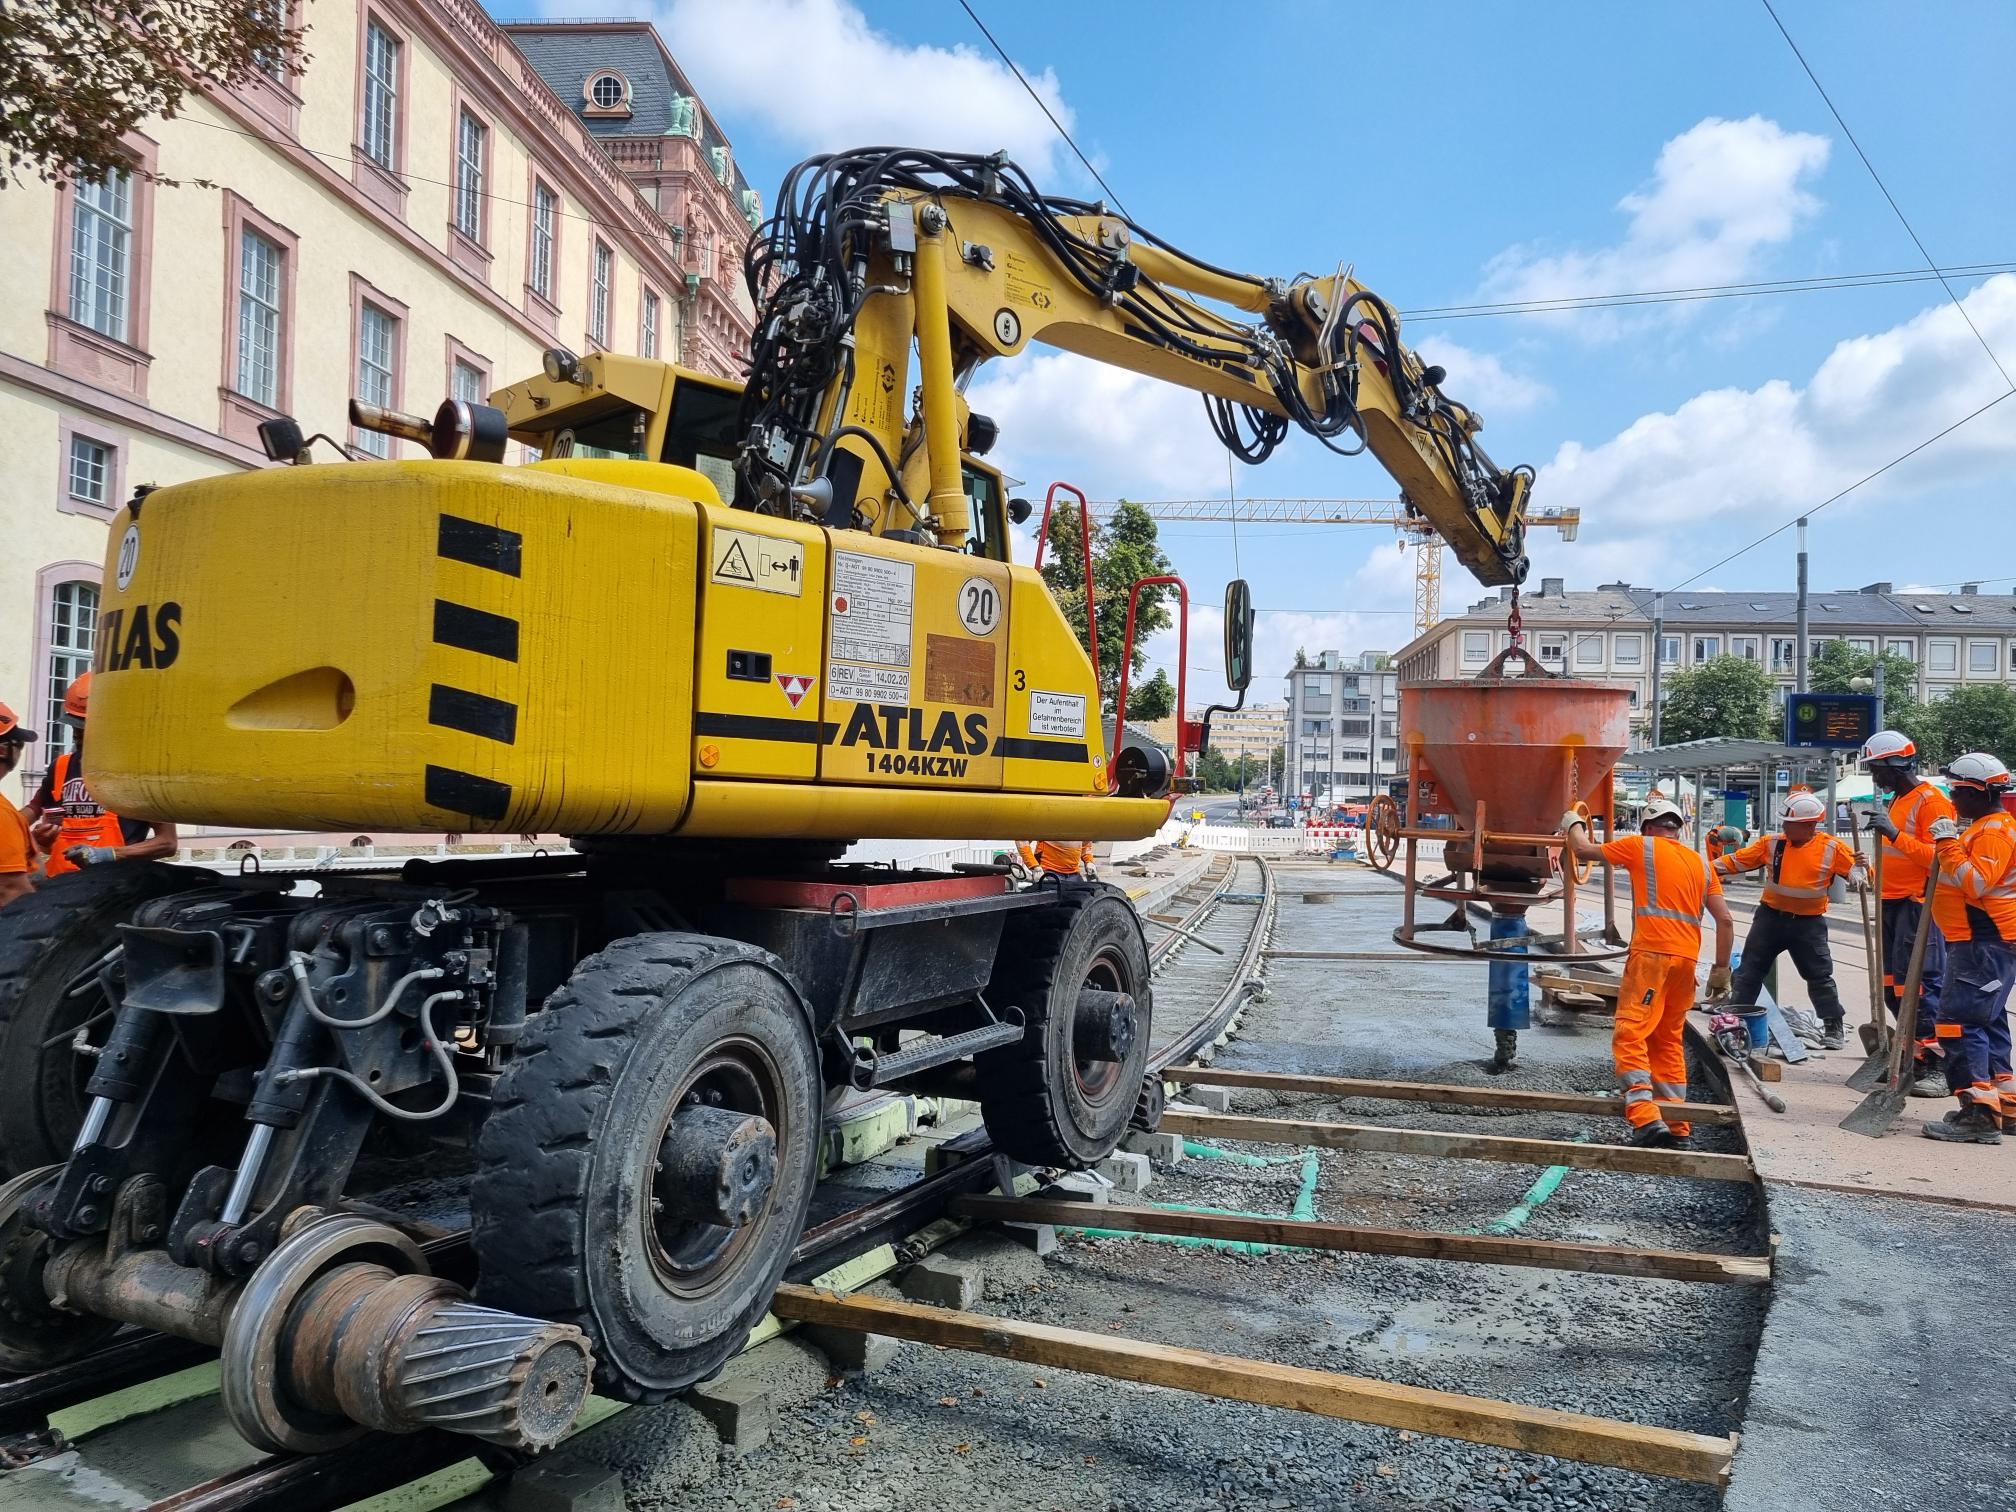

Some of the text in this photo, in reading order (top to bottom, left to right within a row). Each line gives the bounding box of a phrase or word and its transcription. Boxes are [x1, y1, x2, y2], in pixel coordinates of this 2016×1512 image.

[119, 536, 136, 578] 20
[966, 586, 993, 626] 20
[96, 601, 182, 673] TLAS
[831, 667, 837, 678] 6
[838, 668, 854, 680] REV
[876, 672, 908, 686] 14.02.20
[1013, 669, 1026, 692] 3
[830, 684, 907, 701] D-AGT 99 80 9902 500-4
[1036, 696, 1079, 708] Der Aufenthalt
[1054, 706, 1062, 714] im
[1032, 712, 1082, 724] Gefahrenbereich
[840, 703, 989, 756] ATLAS
[1050, 724, 1077, 733] verboten
[866, 752, 968, 778] 1404KZW
[76, 805, 94, 814] ROAD
